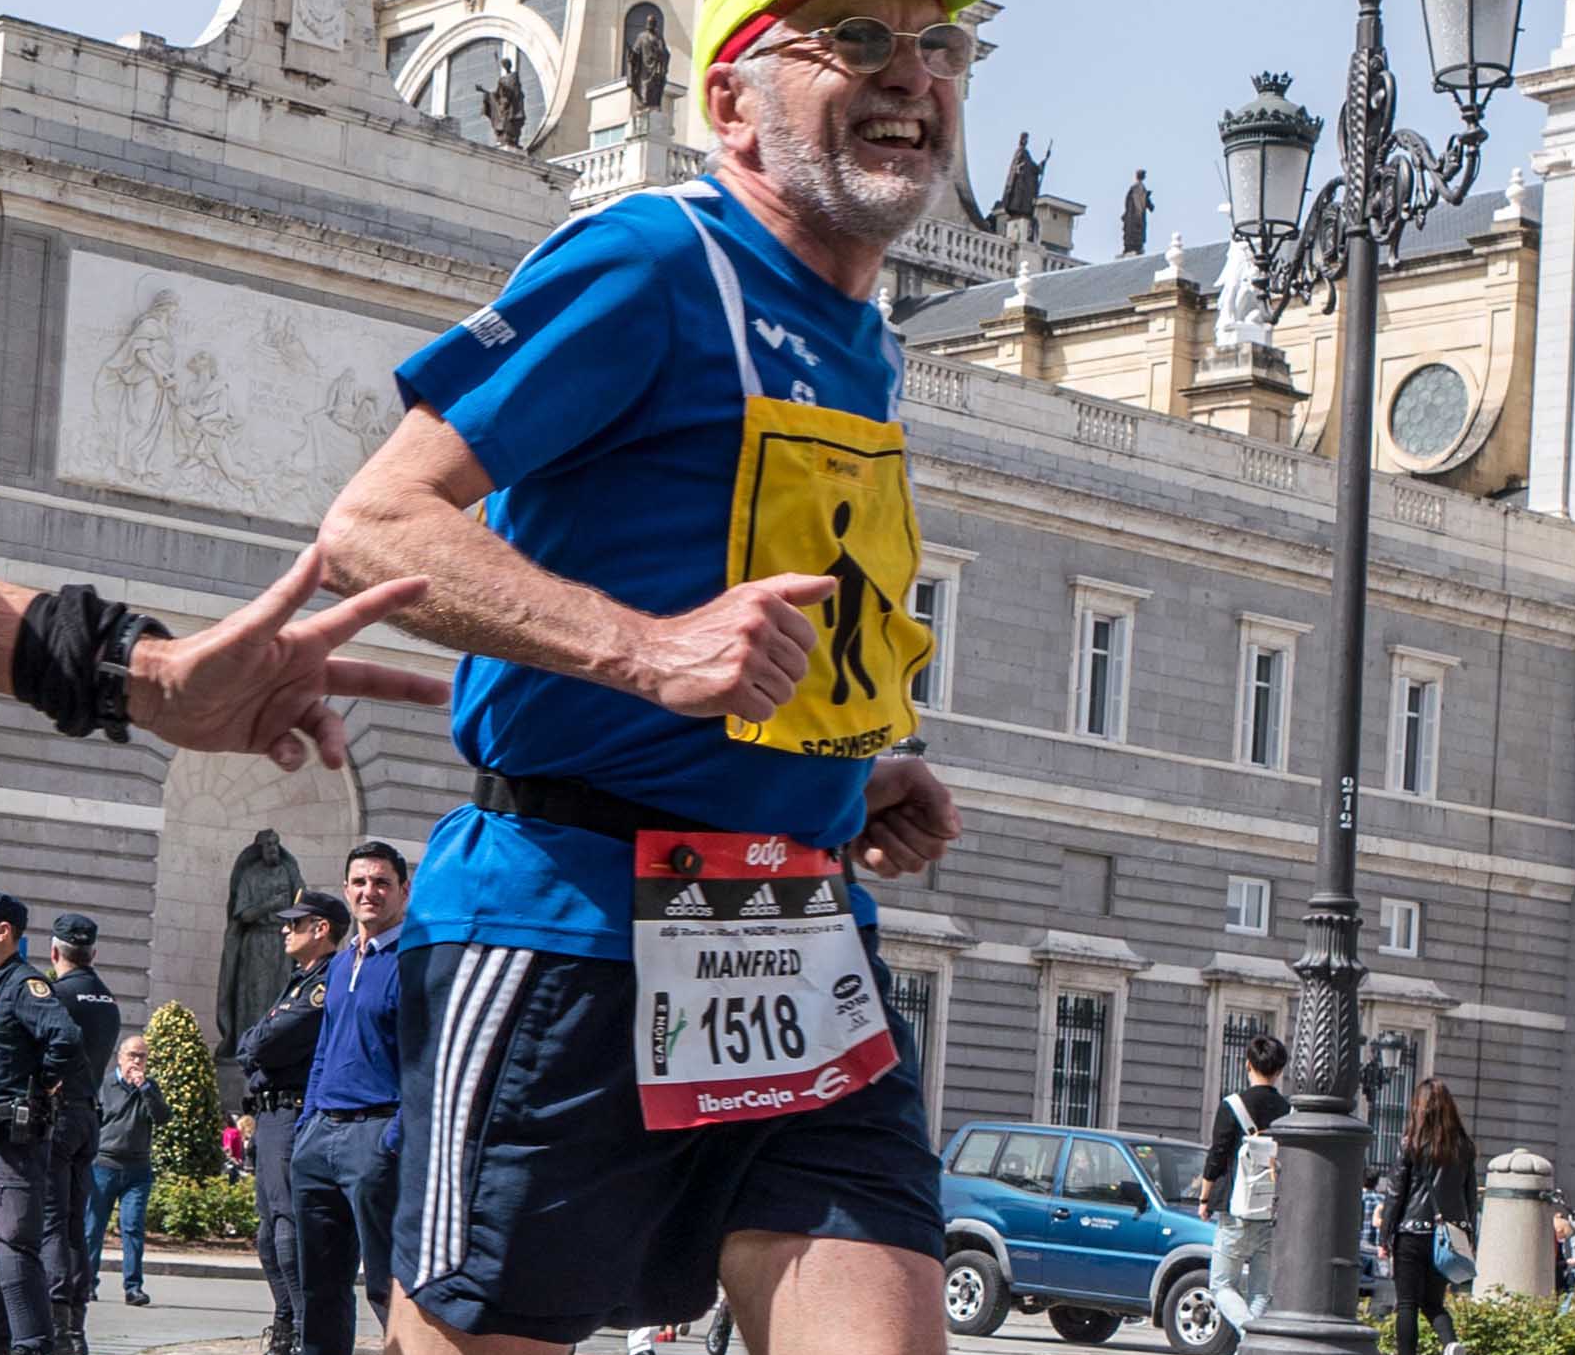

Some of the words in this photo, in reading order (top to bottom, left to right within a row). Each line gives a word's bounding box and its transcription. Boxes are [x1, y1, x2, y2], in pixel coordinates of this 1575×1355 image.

[746, 836, 788, 872] edp
[664, 904, 714, 917] adidas
[738, 903, 782, 916] adidas
[803, 902, 839, 915] adidas
[696, 949, 802, 979] MANFRED
[655, 1015, 666, 1064] CAJÓN
[700, 994, 806, 1065] 1518
[697, 1088, 795, 1113] iberCaja
